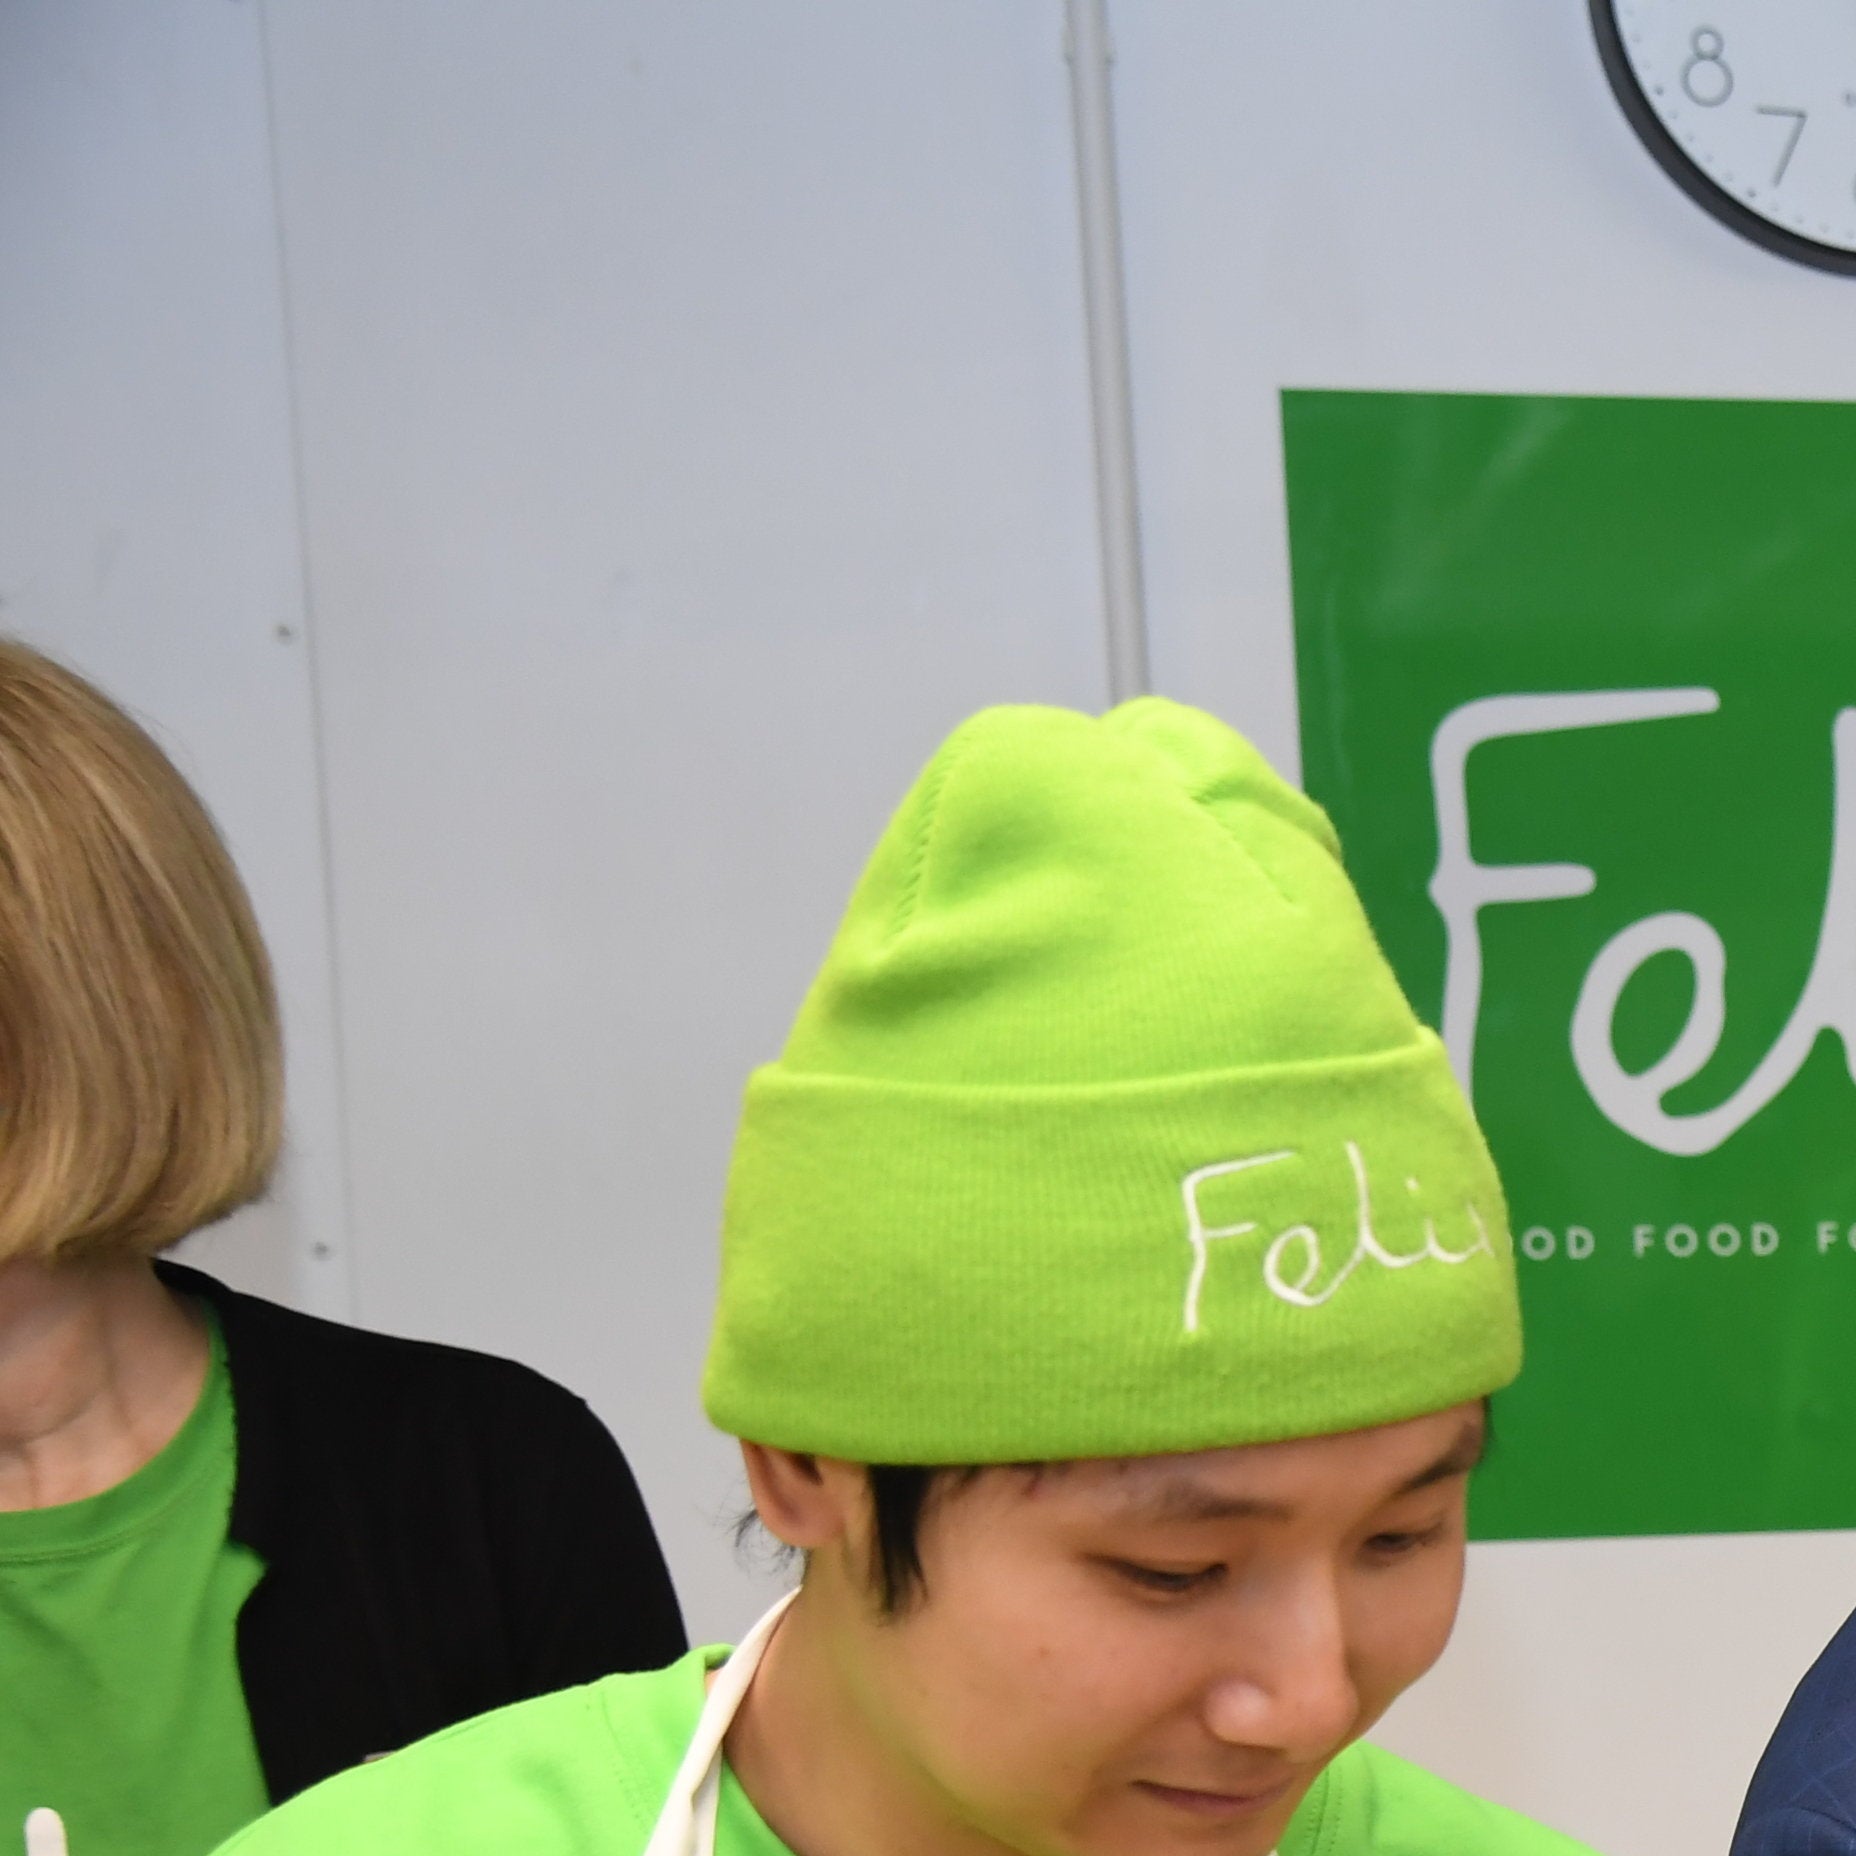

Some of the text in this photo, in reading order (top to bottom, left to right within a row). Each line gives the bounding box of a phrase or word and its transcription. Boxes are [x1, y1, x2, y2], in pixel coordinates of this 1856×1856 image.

[1680, 25, 1735, 107] 8
[1756, 104, 1807, 188] 7
[1521, 1225, 1596, 1262] OD
[1633, 1223, 1781, 1260] FOOD
